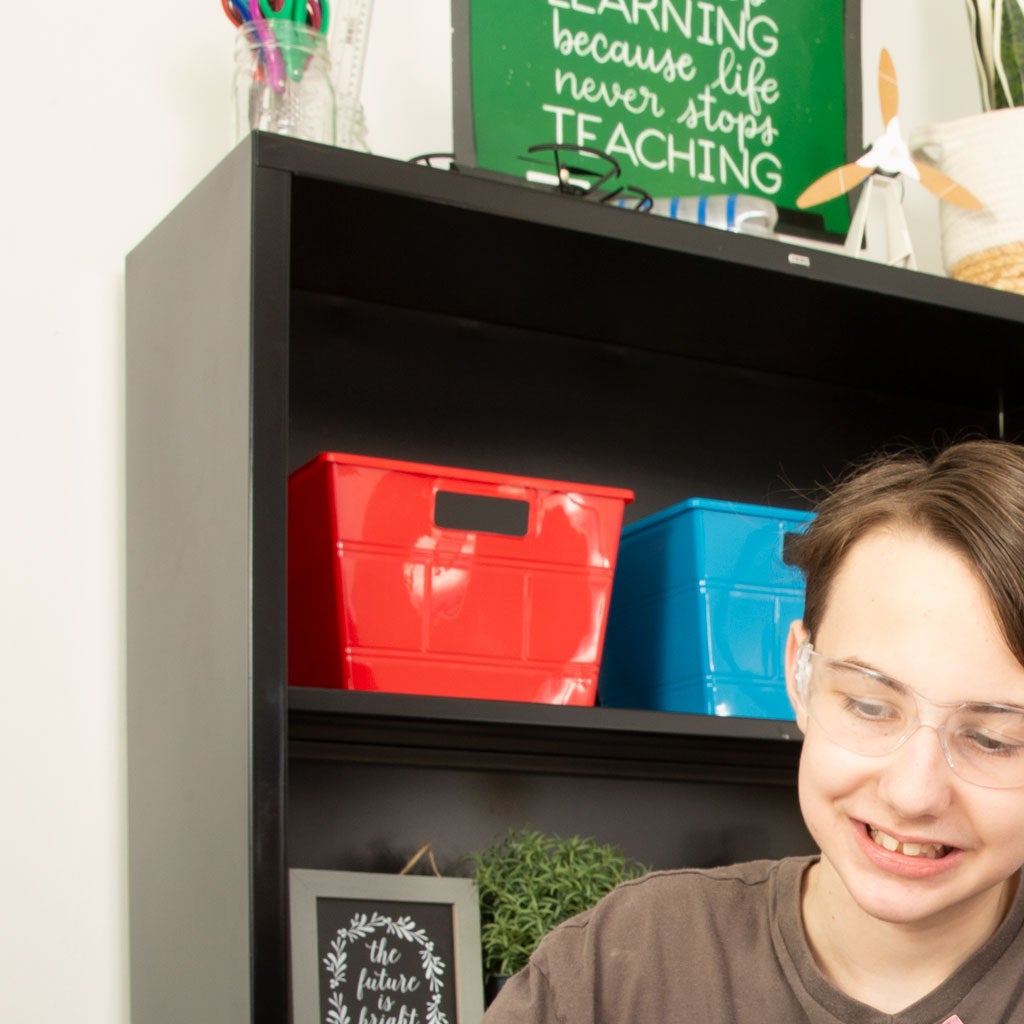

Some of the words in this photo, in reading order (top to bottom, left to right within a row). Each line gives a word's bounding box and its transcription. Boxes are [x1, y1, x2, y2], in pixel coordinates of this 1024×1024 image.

[548, 0, 779, 58] RNING
[553, 8, 697, 82] because
[711, 47, 780, 116] life
[555, 68, 665, 117] never
[677, 84, 779, 154] stops
[543, 104, 782, 194] TEACHING
[365, 937, 402, 966] the
[356, 968, 420, 1000] future
[377, 994, 395, 1012] is
